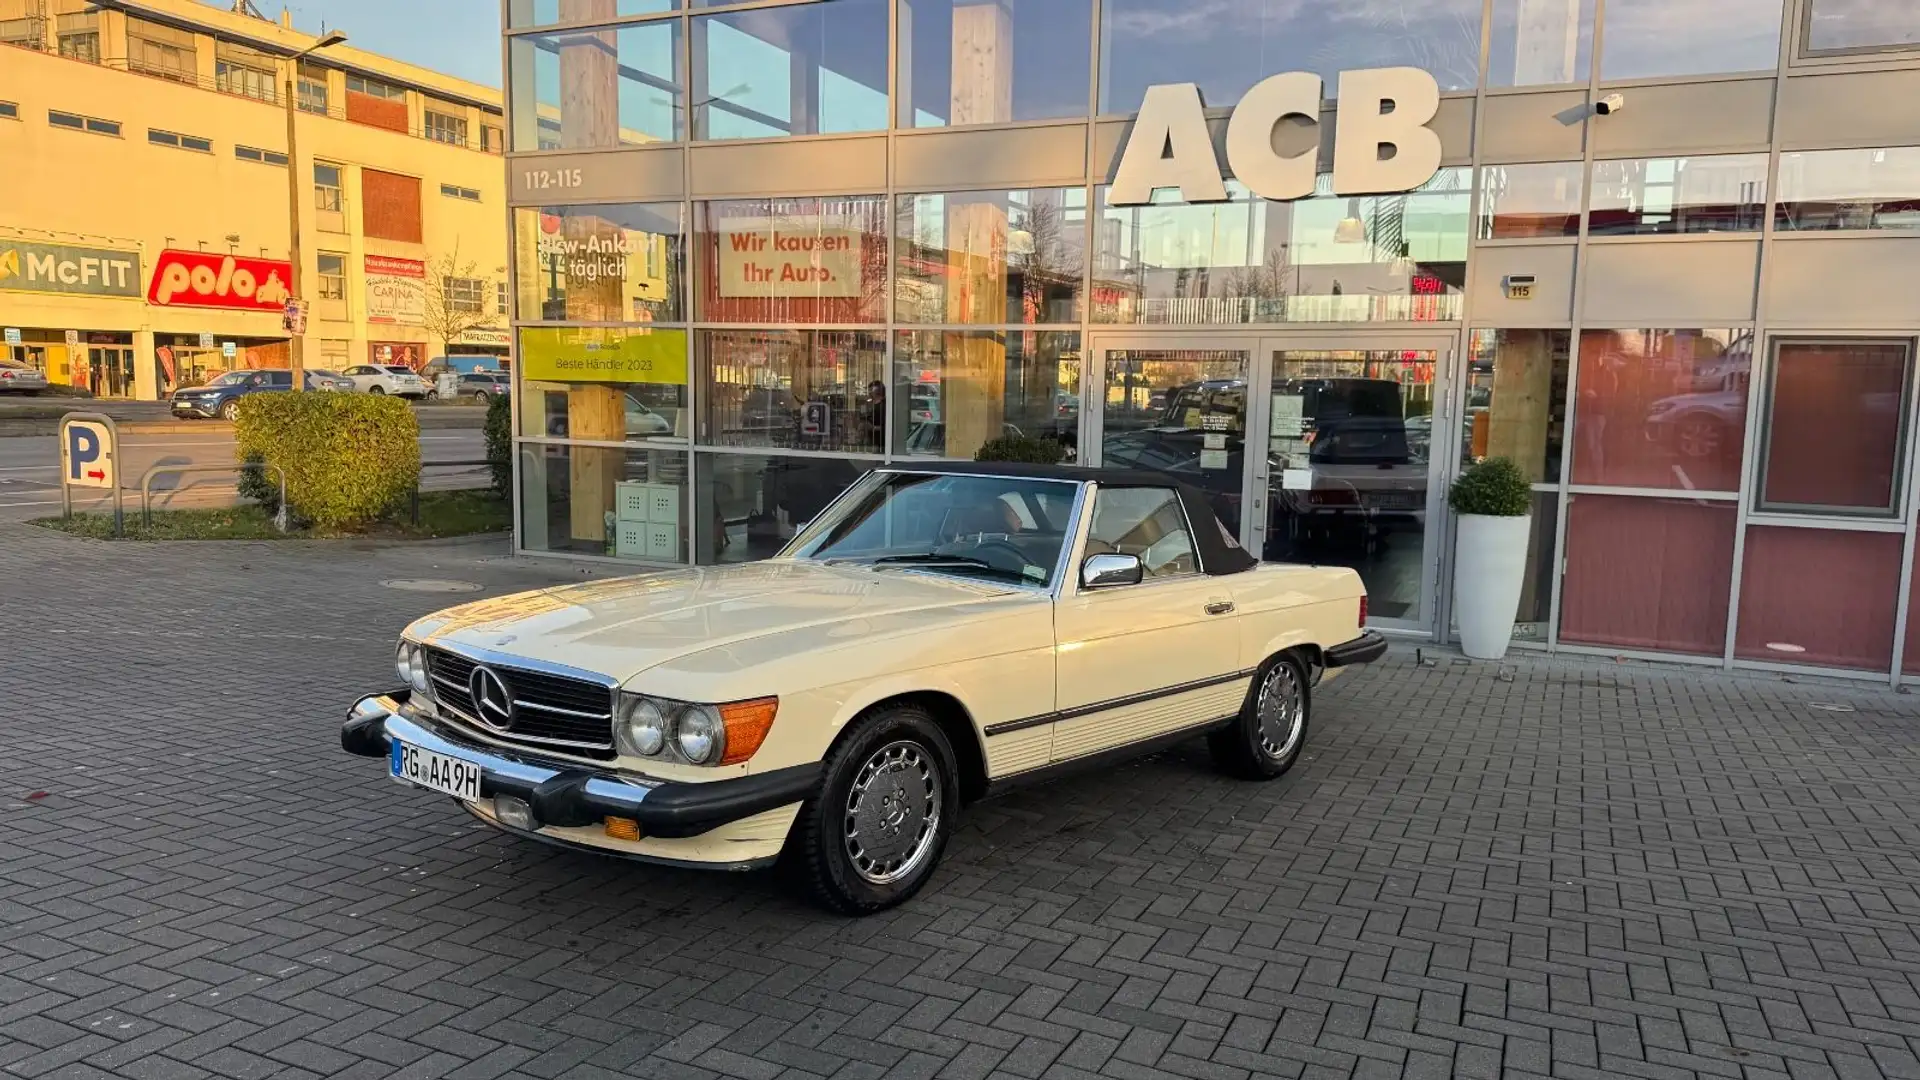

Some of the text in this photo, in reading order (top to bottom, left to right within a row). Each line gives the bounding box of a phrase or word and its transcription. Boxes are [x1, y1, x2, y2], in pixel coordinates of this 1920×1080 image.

[1108, 66, 1442, 206] ACB
[524, 168, 582, 190] 112-115
[730, 232, 767, 251] Wir
[26, 252, 132, 288] McFIT
[569, 256, 627, 281] täglich
[744, 262, 836, 282] Ihr Auto.
[156, 256, 256, 305] polo
[1511, 287, 1529, 296] 115
[373, 285, 414, 302] CARINA
[556, 358, 653, 371] Beste Händler 2023
[69, 426, 100, 479] P
[401, 745, 478, 798] RG AA9H
